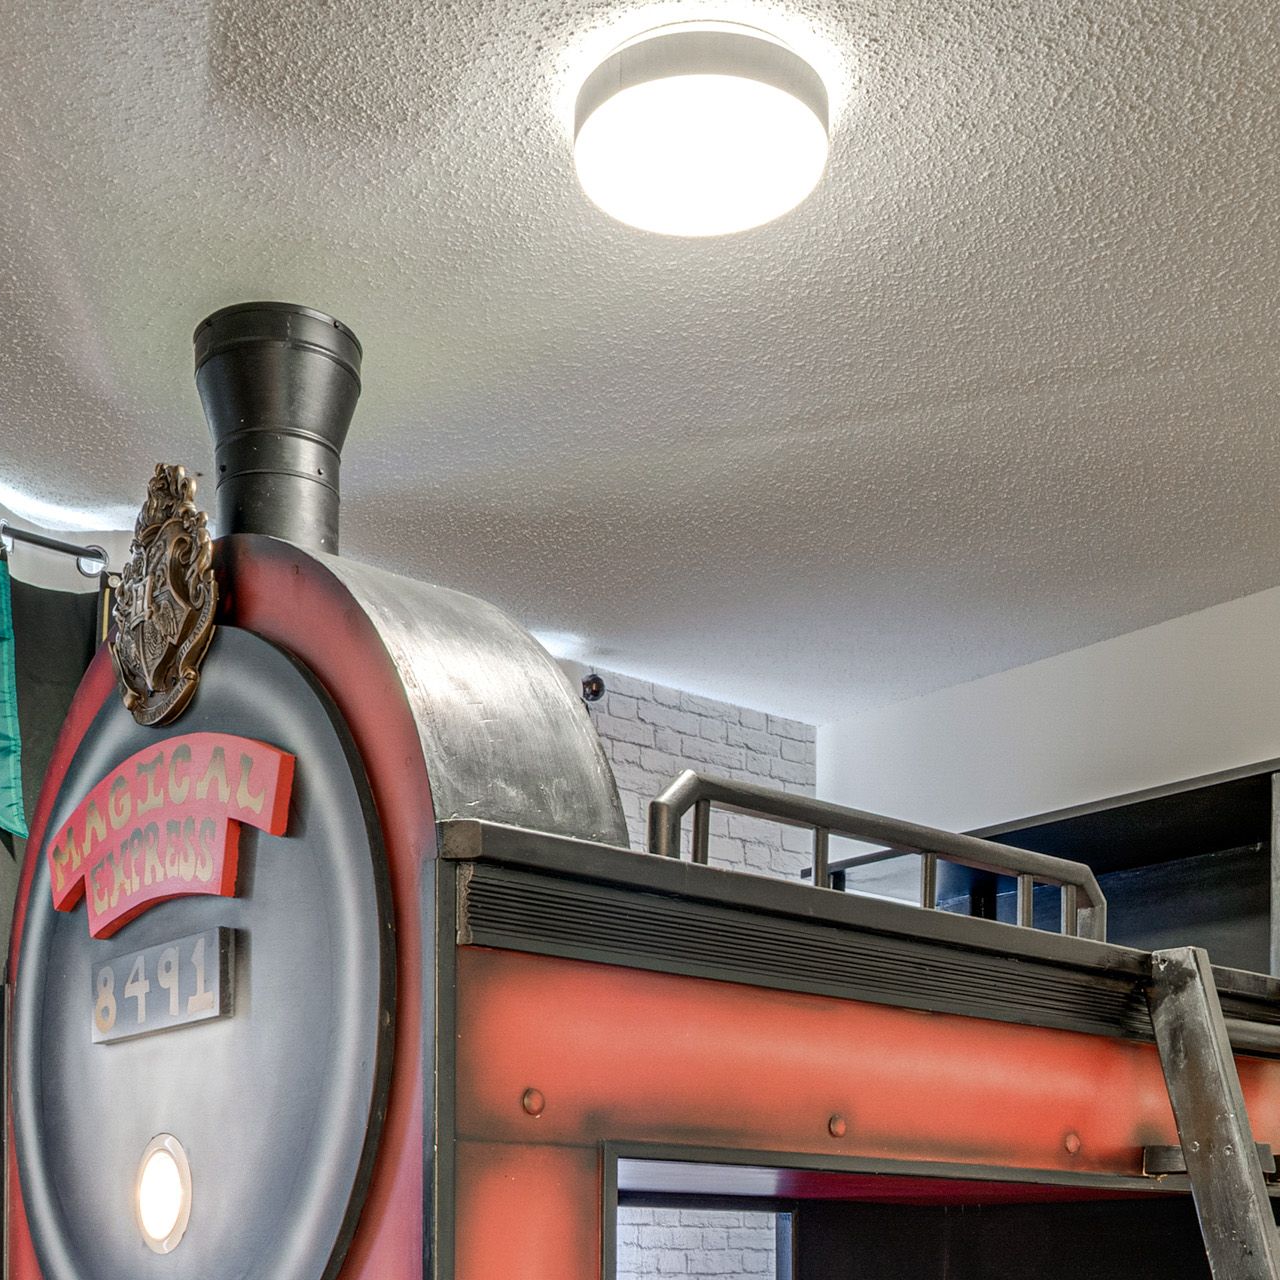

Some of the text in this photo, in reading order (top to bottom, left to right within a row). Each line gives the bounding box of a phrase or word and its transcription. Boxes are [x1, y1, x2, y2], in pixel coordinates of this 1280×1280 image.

[52, 742, 267, 893] MAGICAL
[89, 816, 217, 917] EXPRESS
[94, 937, 216, 1035] 8491
